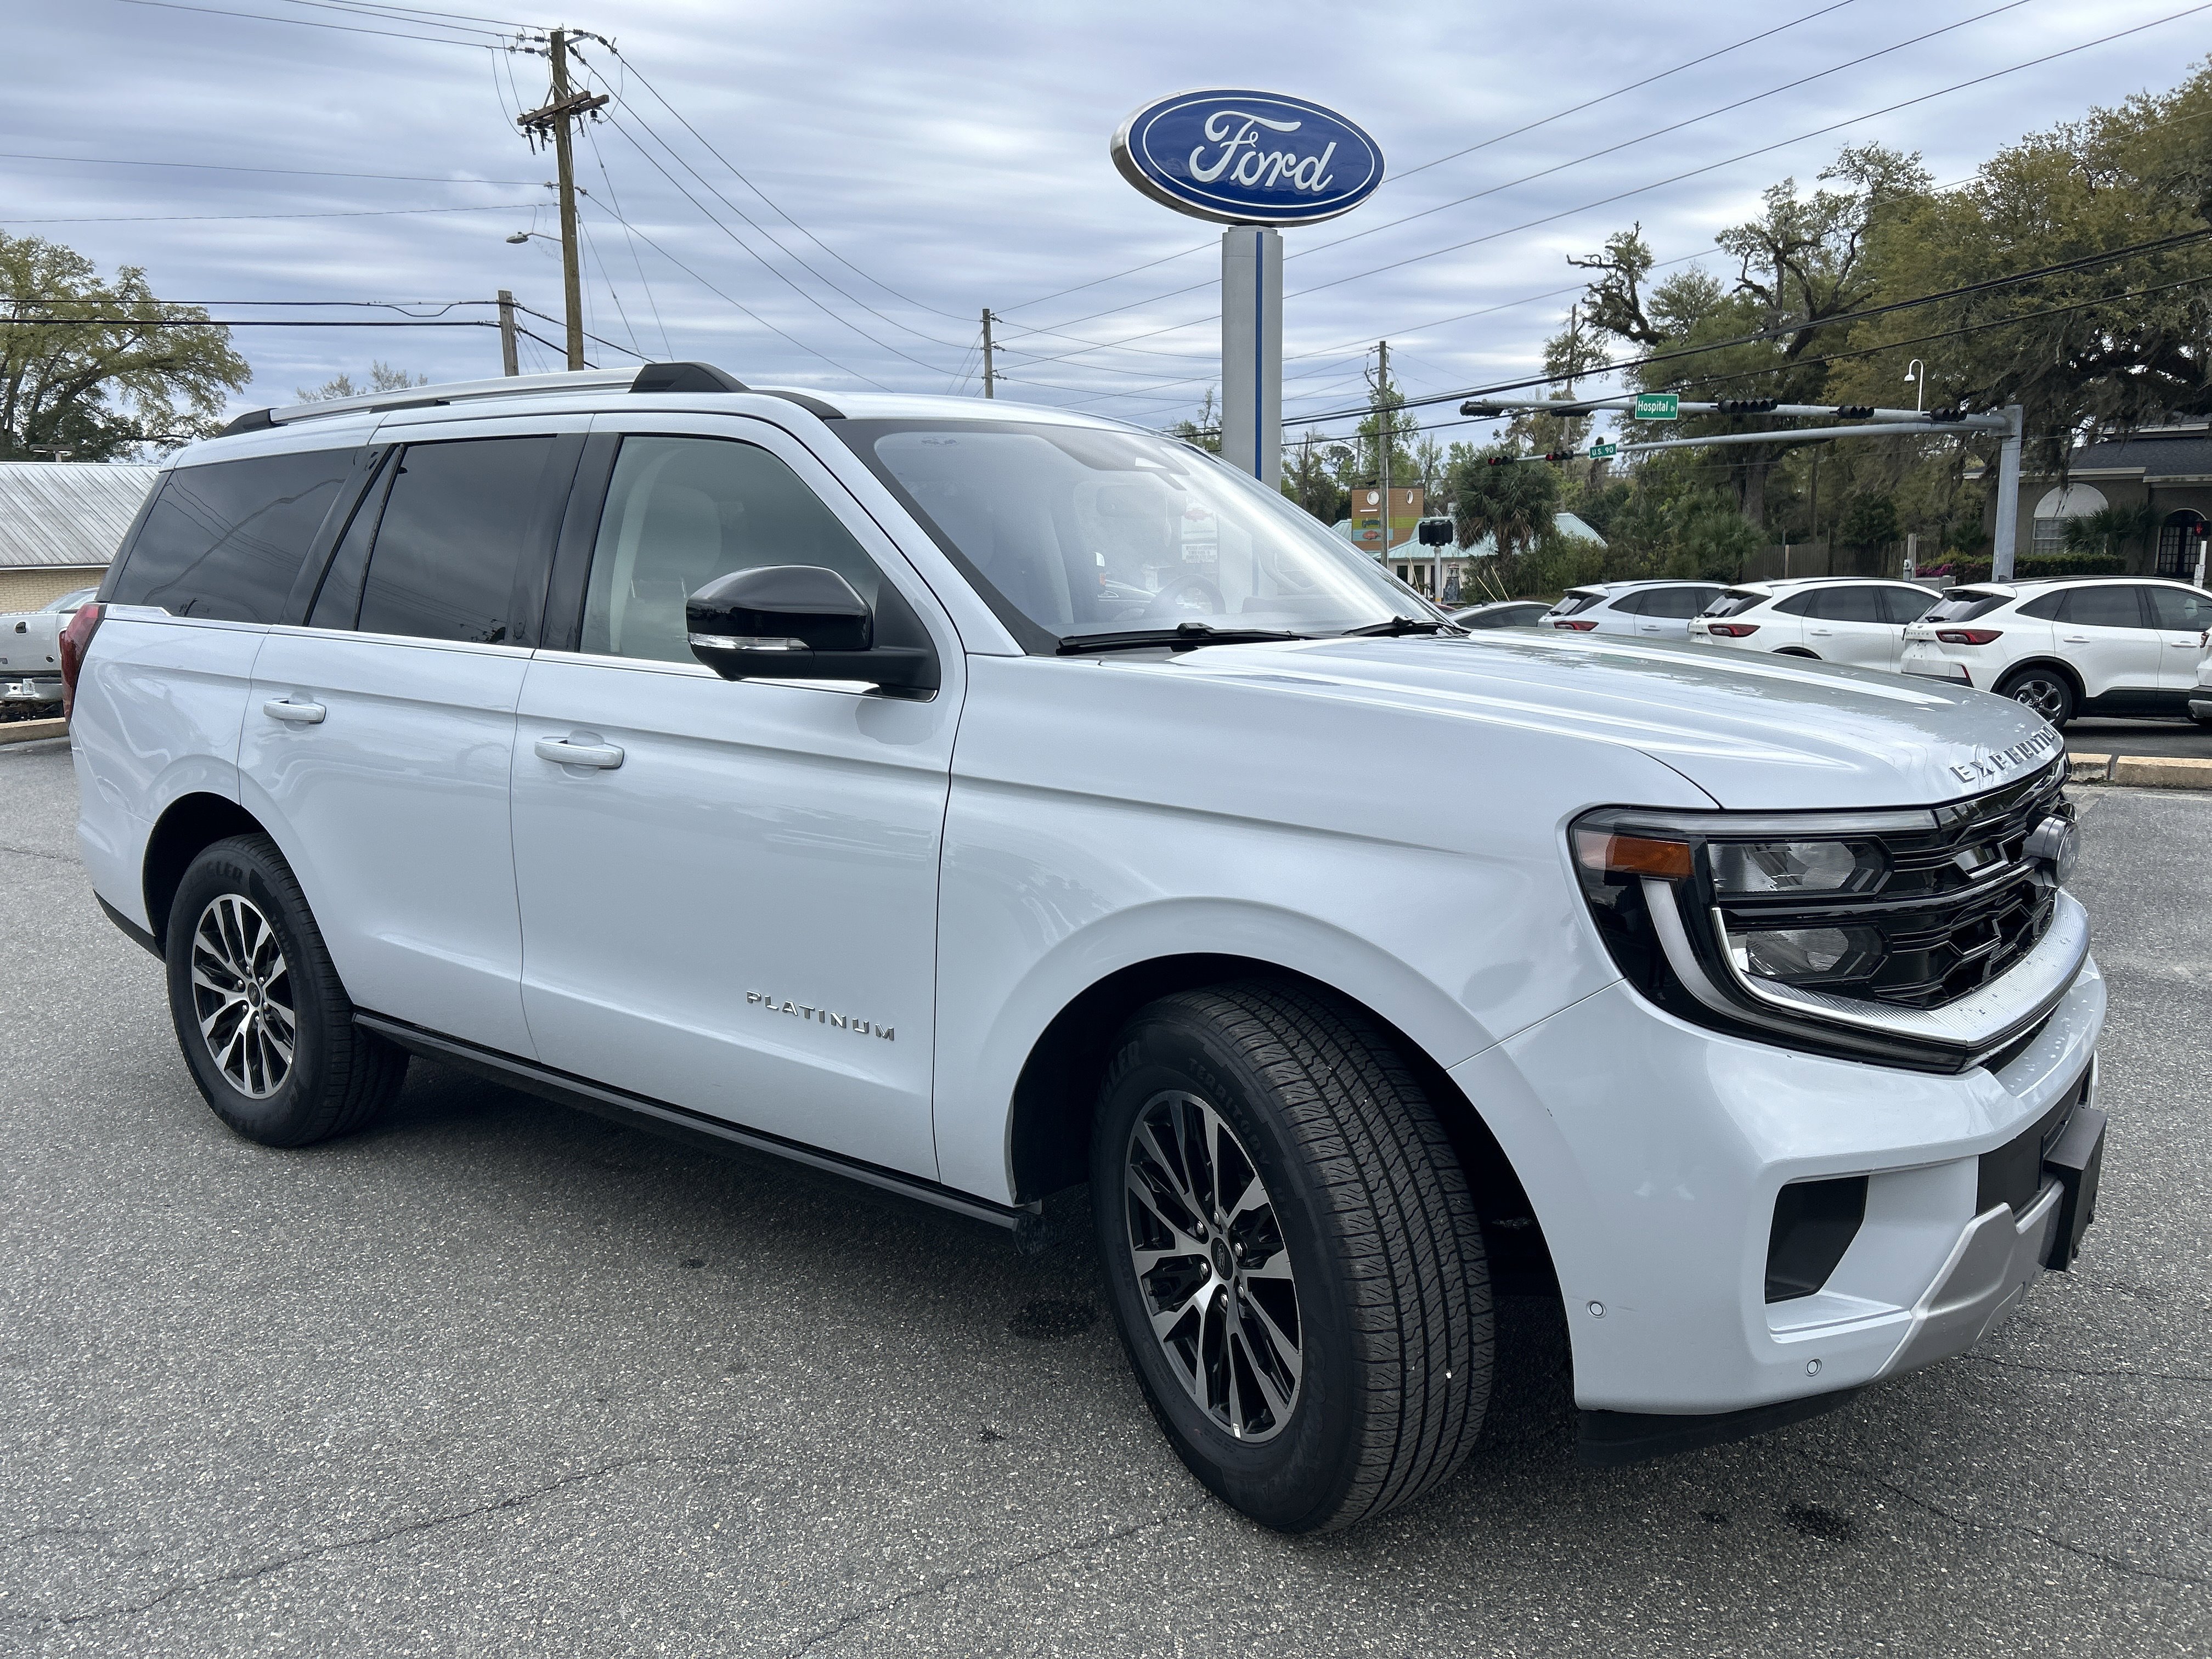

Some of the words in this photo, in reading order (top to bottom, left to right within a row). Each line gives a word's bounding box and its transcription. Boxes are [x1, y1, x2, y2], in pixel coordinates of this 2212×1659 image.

[1189, 110, 1338, 192] Ford
[1638, 400, 1668, 414] Hospital
[1592, 448, 1603, 456] U.S.
[1605, 445, 1613, 454] 90
[746, 990, 895, 1041] PLATINUM
[1188, 1057, 1272, 1165] TERRITORY
